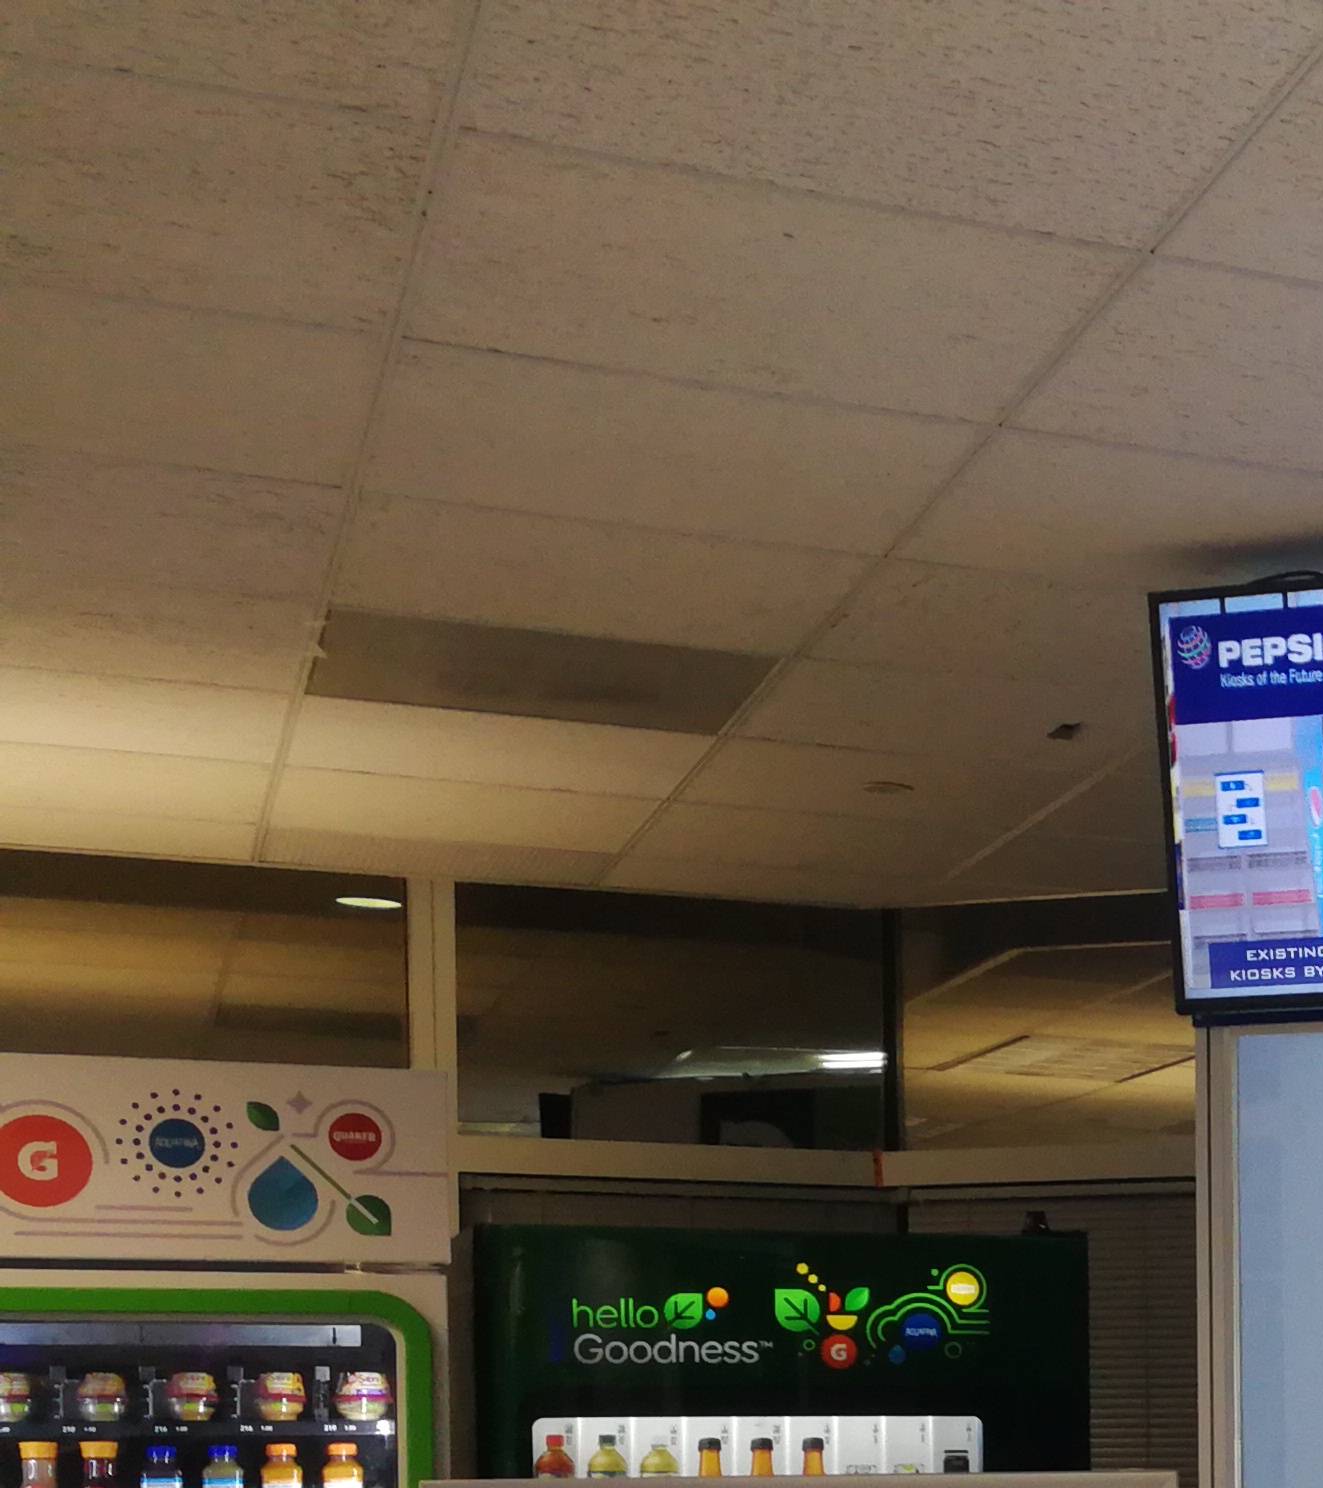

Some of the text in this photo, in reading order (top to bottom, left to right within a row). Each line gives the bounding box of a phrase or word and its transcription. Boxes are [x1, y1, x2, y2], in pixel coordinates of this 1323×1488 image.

[1220, 668, 1323, 688] Kiosks of the Future
[1230, 966, 1296, 982] KIOSKS
[18, 1141, 58, 1181] G
[572, 1298, 659, 1330] hello
[830, 1343, 848, 1361] G
